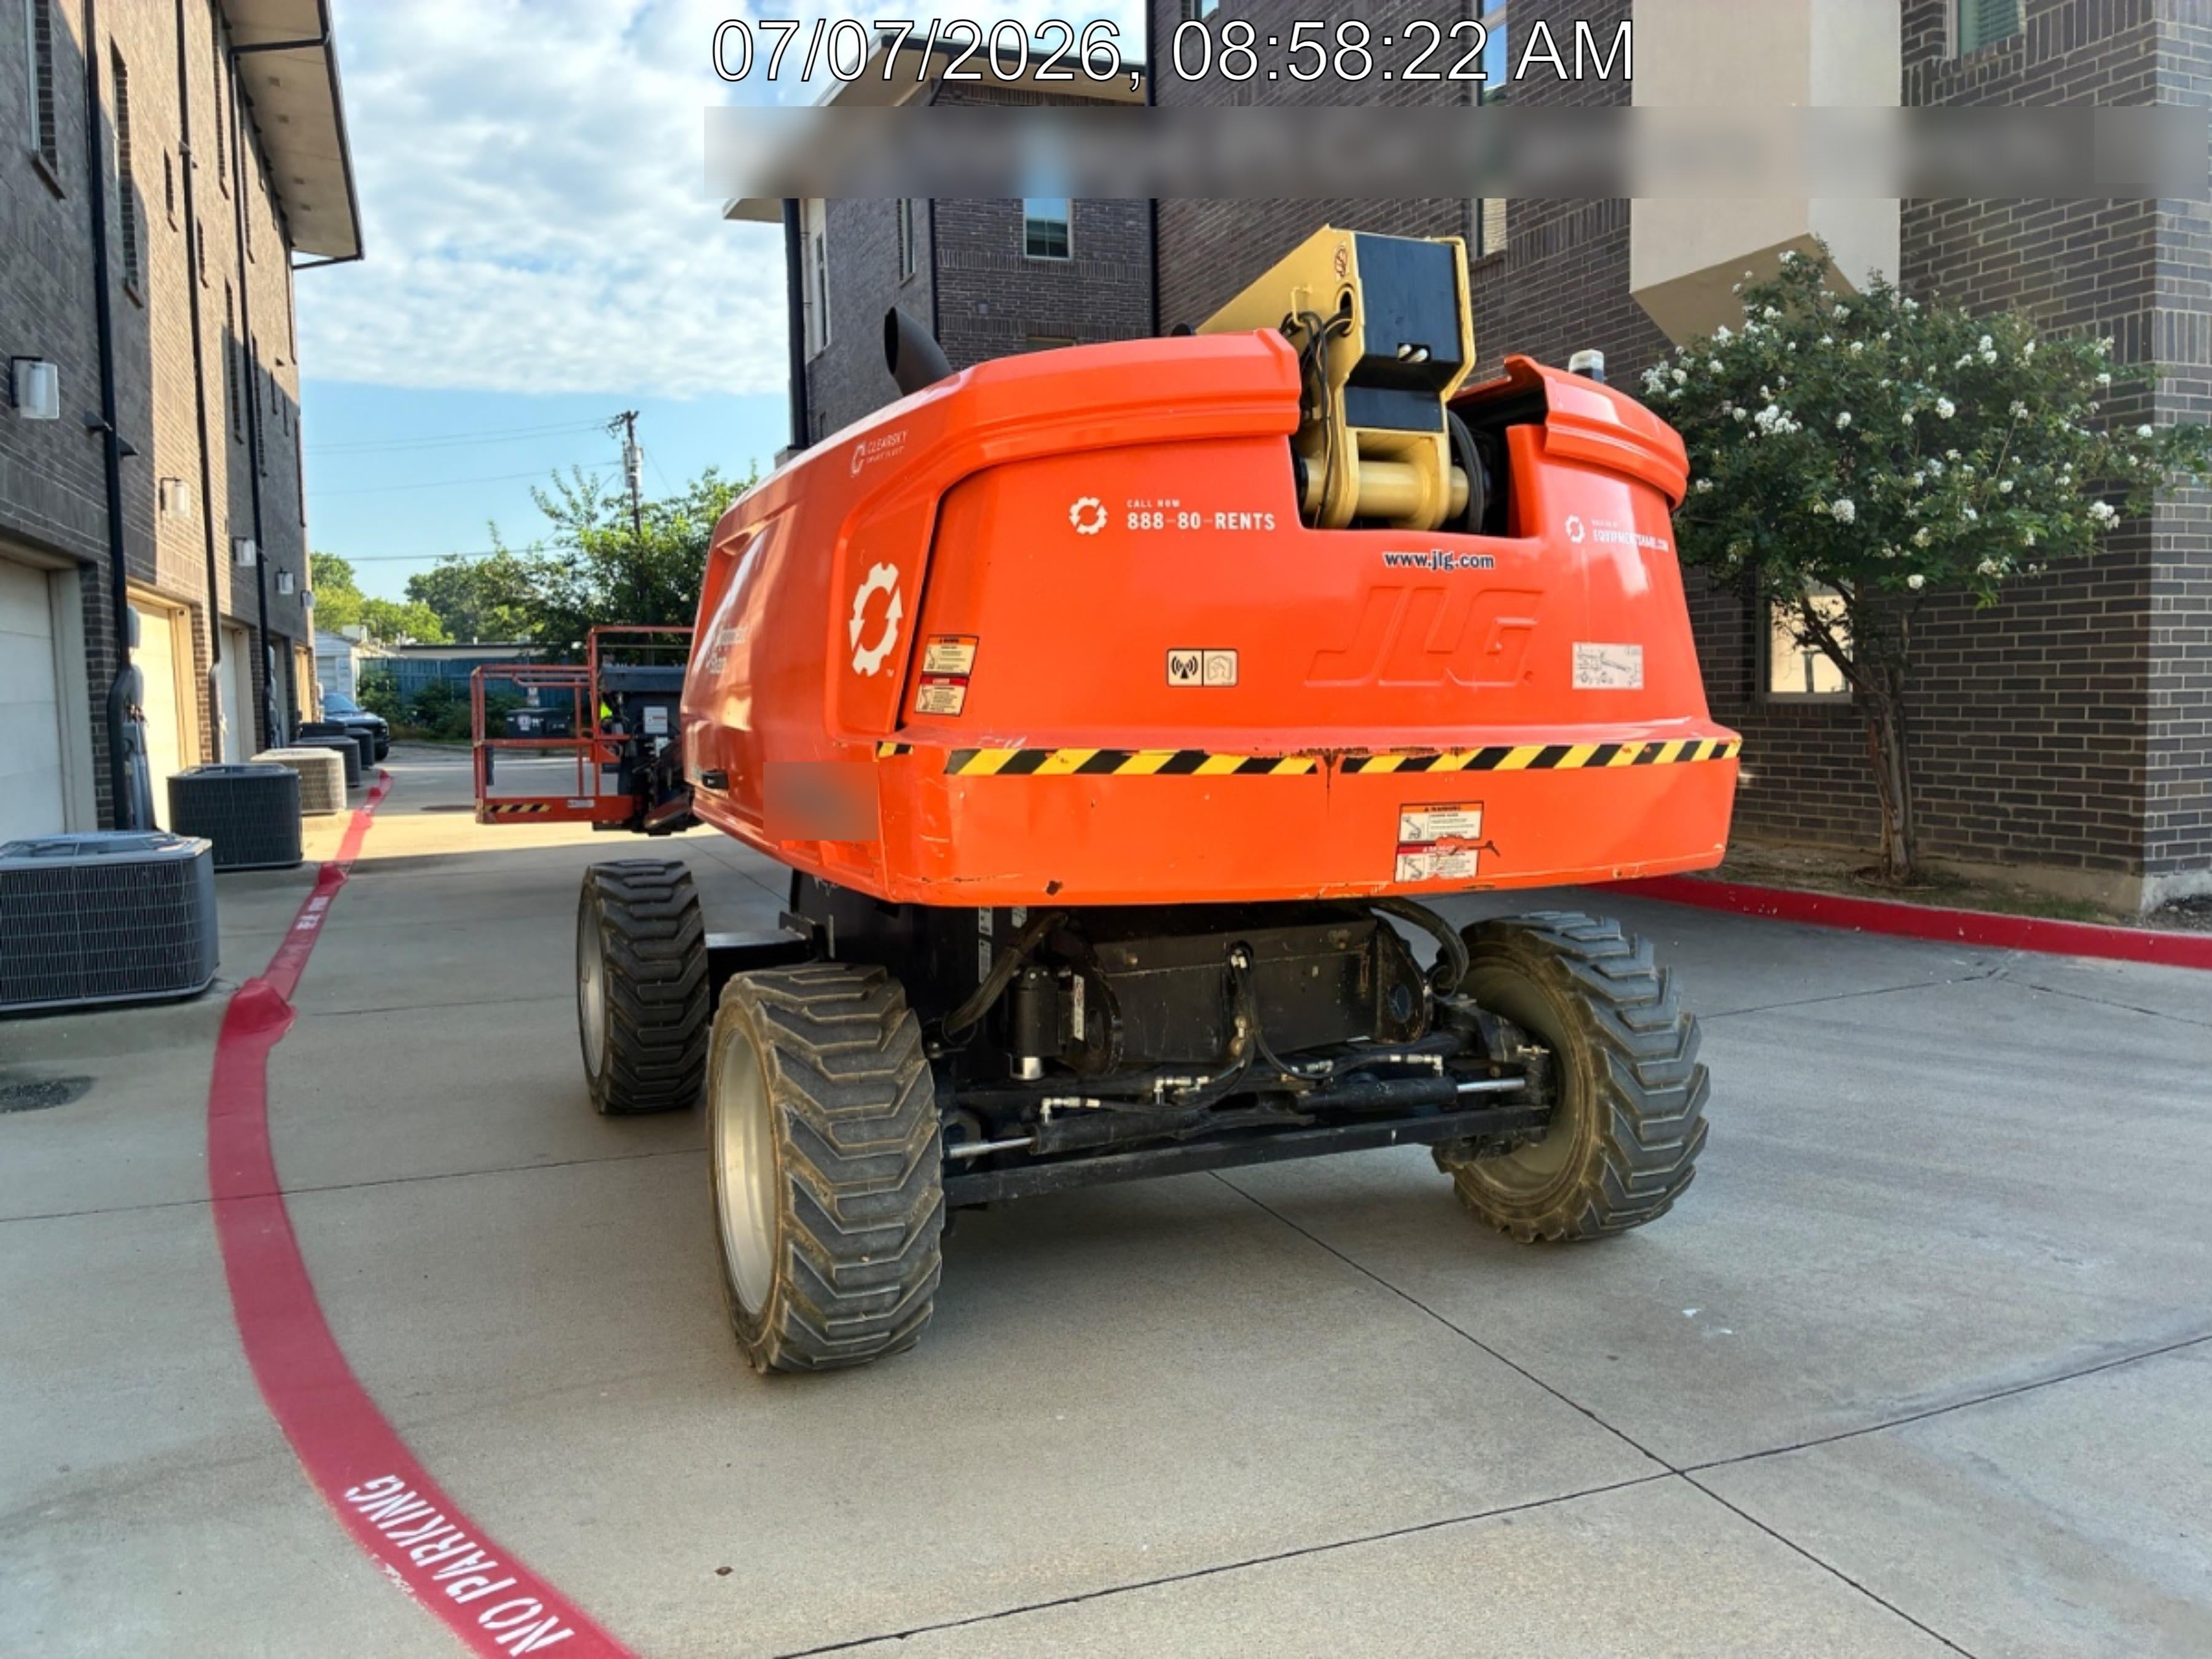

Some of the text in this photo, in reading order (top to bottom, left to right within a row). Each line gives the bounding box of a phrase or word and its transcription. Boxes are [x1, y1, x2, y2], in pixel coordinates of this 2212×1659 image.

[1127, 499, 1180, 508] CALL NOW
[1383, 549, 1494, 570] www.jlg.com
[1304, 586, 1543, 686] JLG
[343, 1475, 575, 1658] NO PARKING
